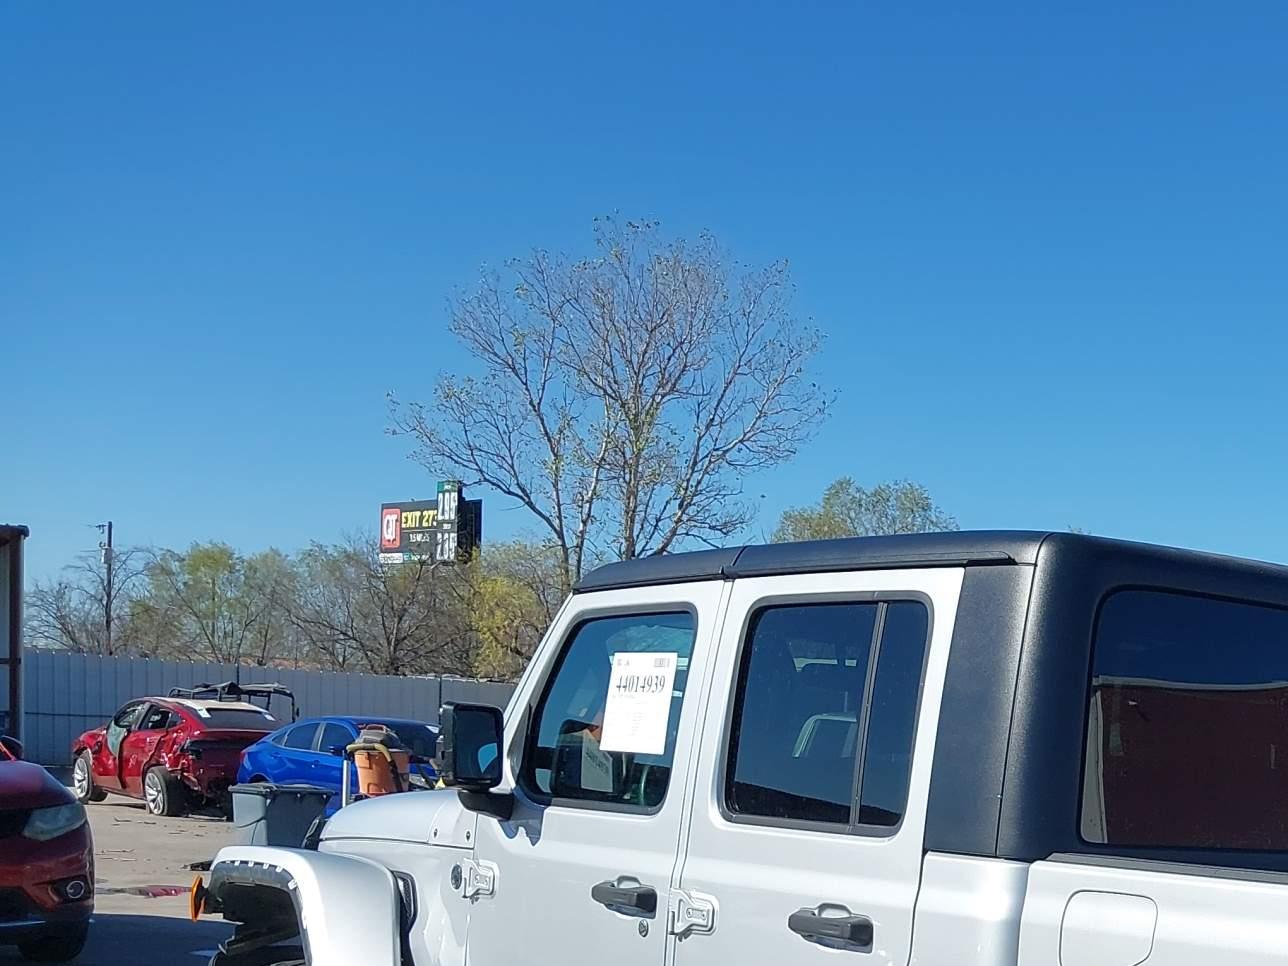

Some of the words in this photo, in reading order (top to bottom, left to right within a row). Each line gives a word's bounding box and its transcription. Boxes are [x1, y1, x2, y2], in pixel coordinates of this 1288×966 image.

[383, 513, 398, 543] QT
[401, 511, 421, 528] EXIT
[616, 675, 666, 693] 44014939
